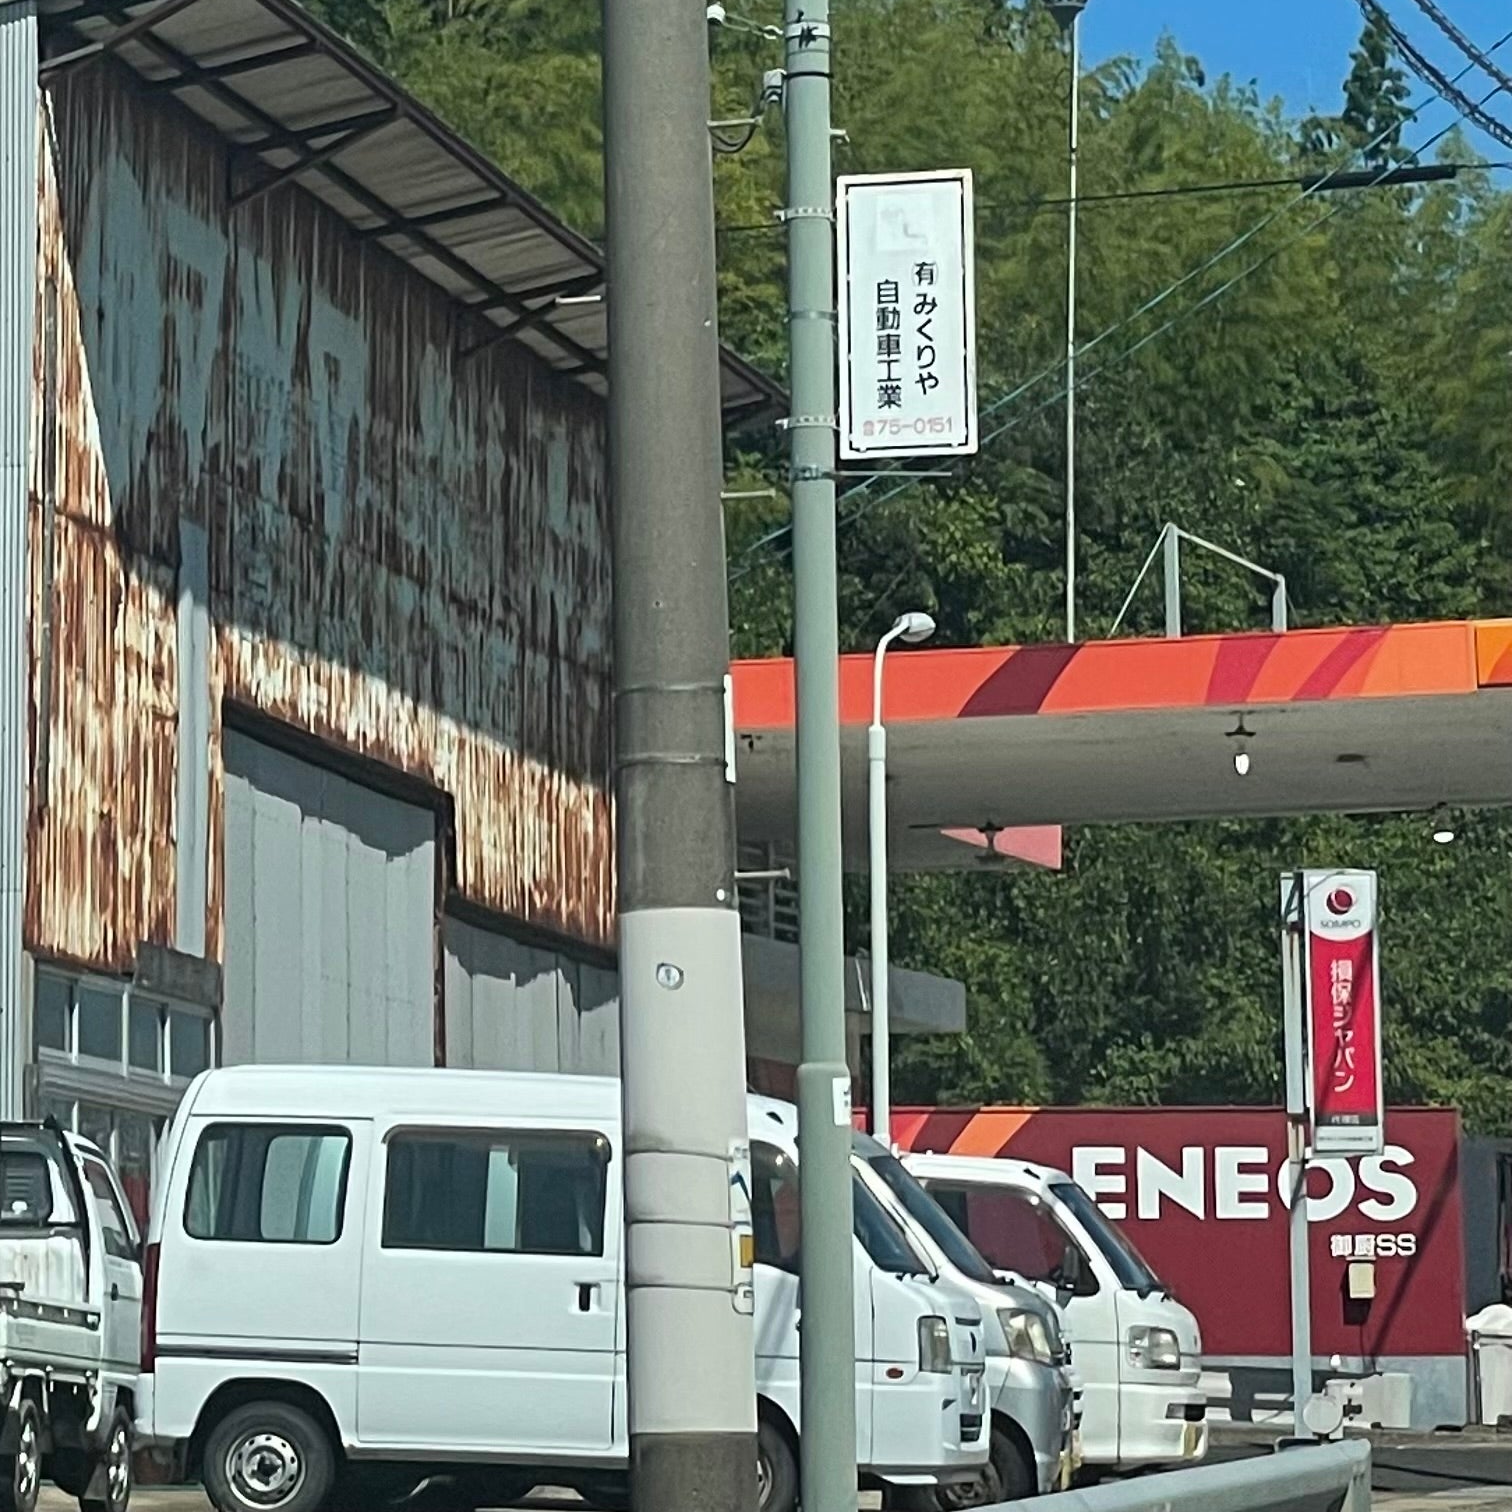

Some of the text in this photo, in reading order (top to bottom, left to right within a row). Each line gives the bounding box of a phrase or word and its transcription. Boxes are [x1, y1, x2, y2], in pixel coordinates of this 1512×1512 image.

[876, 278, 902, 409] 自動車工業
[1330, 959, 1354, 1092] 損保ジャパン
[1072, 1145, 1418, 1222] ENEOS
